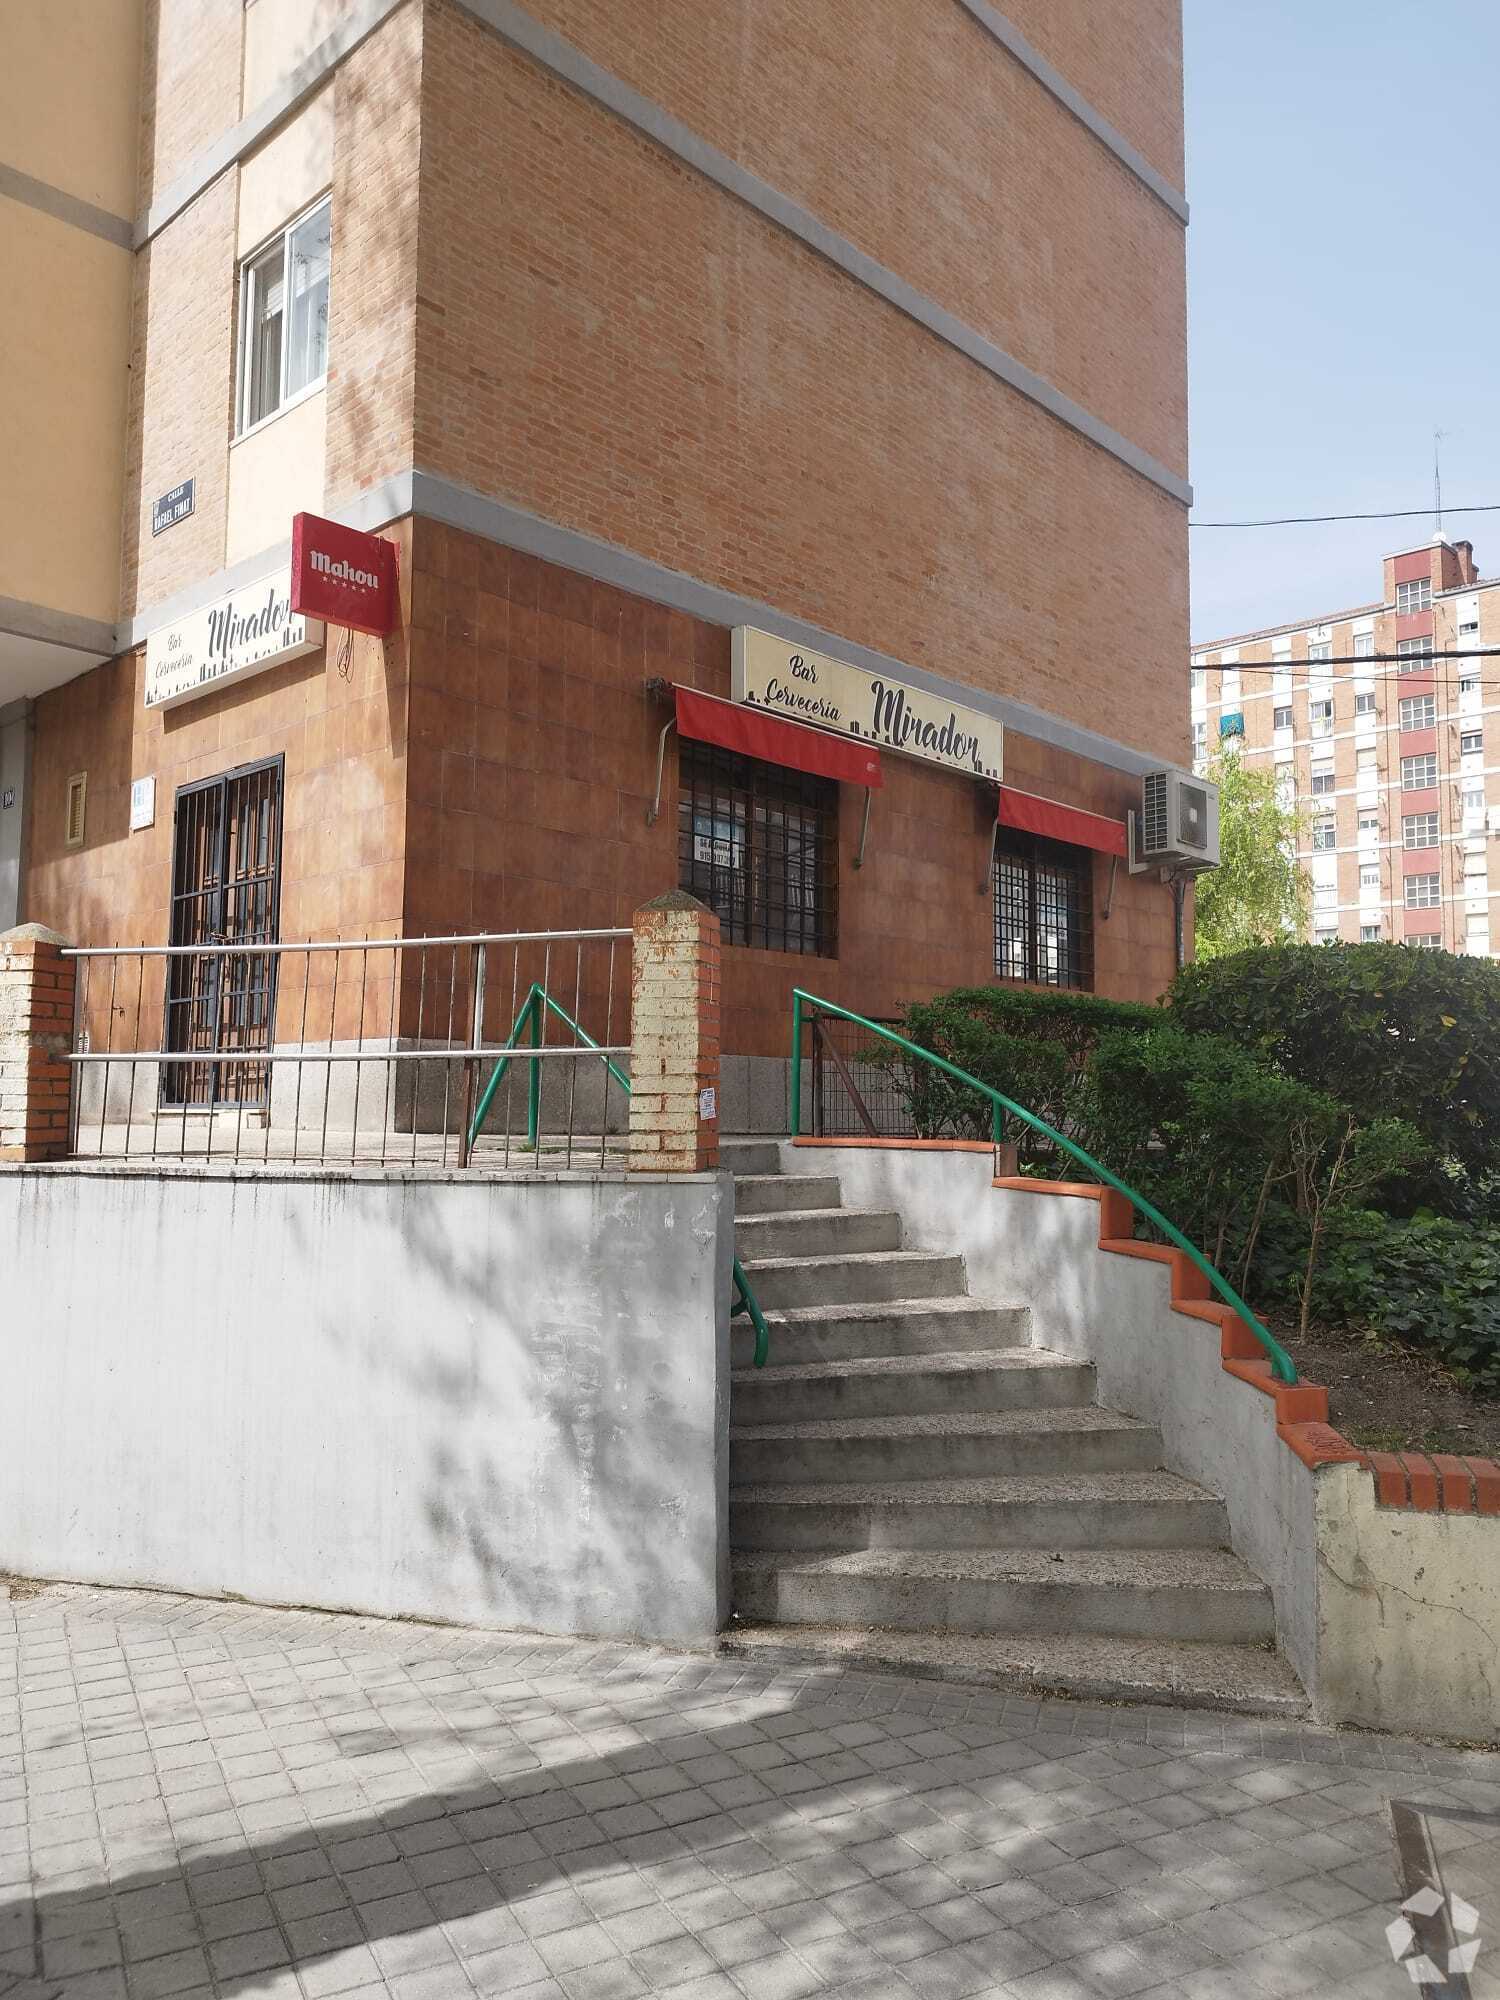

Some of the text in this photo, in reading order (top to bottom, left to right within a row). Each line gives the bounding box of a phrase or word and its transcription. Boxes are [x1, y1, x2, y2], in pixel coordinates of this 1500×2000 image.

[310, 550, 379, 589] Mahou
[789, 654, 818, 684] Bar
[870, 680, 981, 762] Mirador
